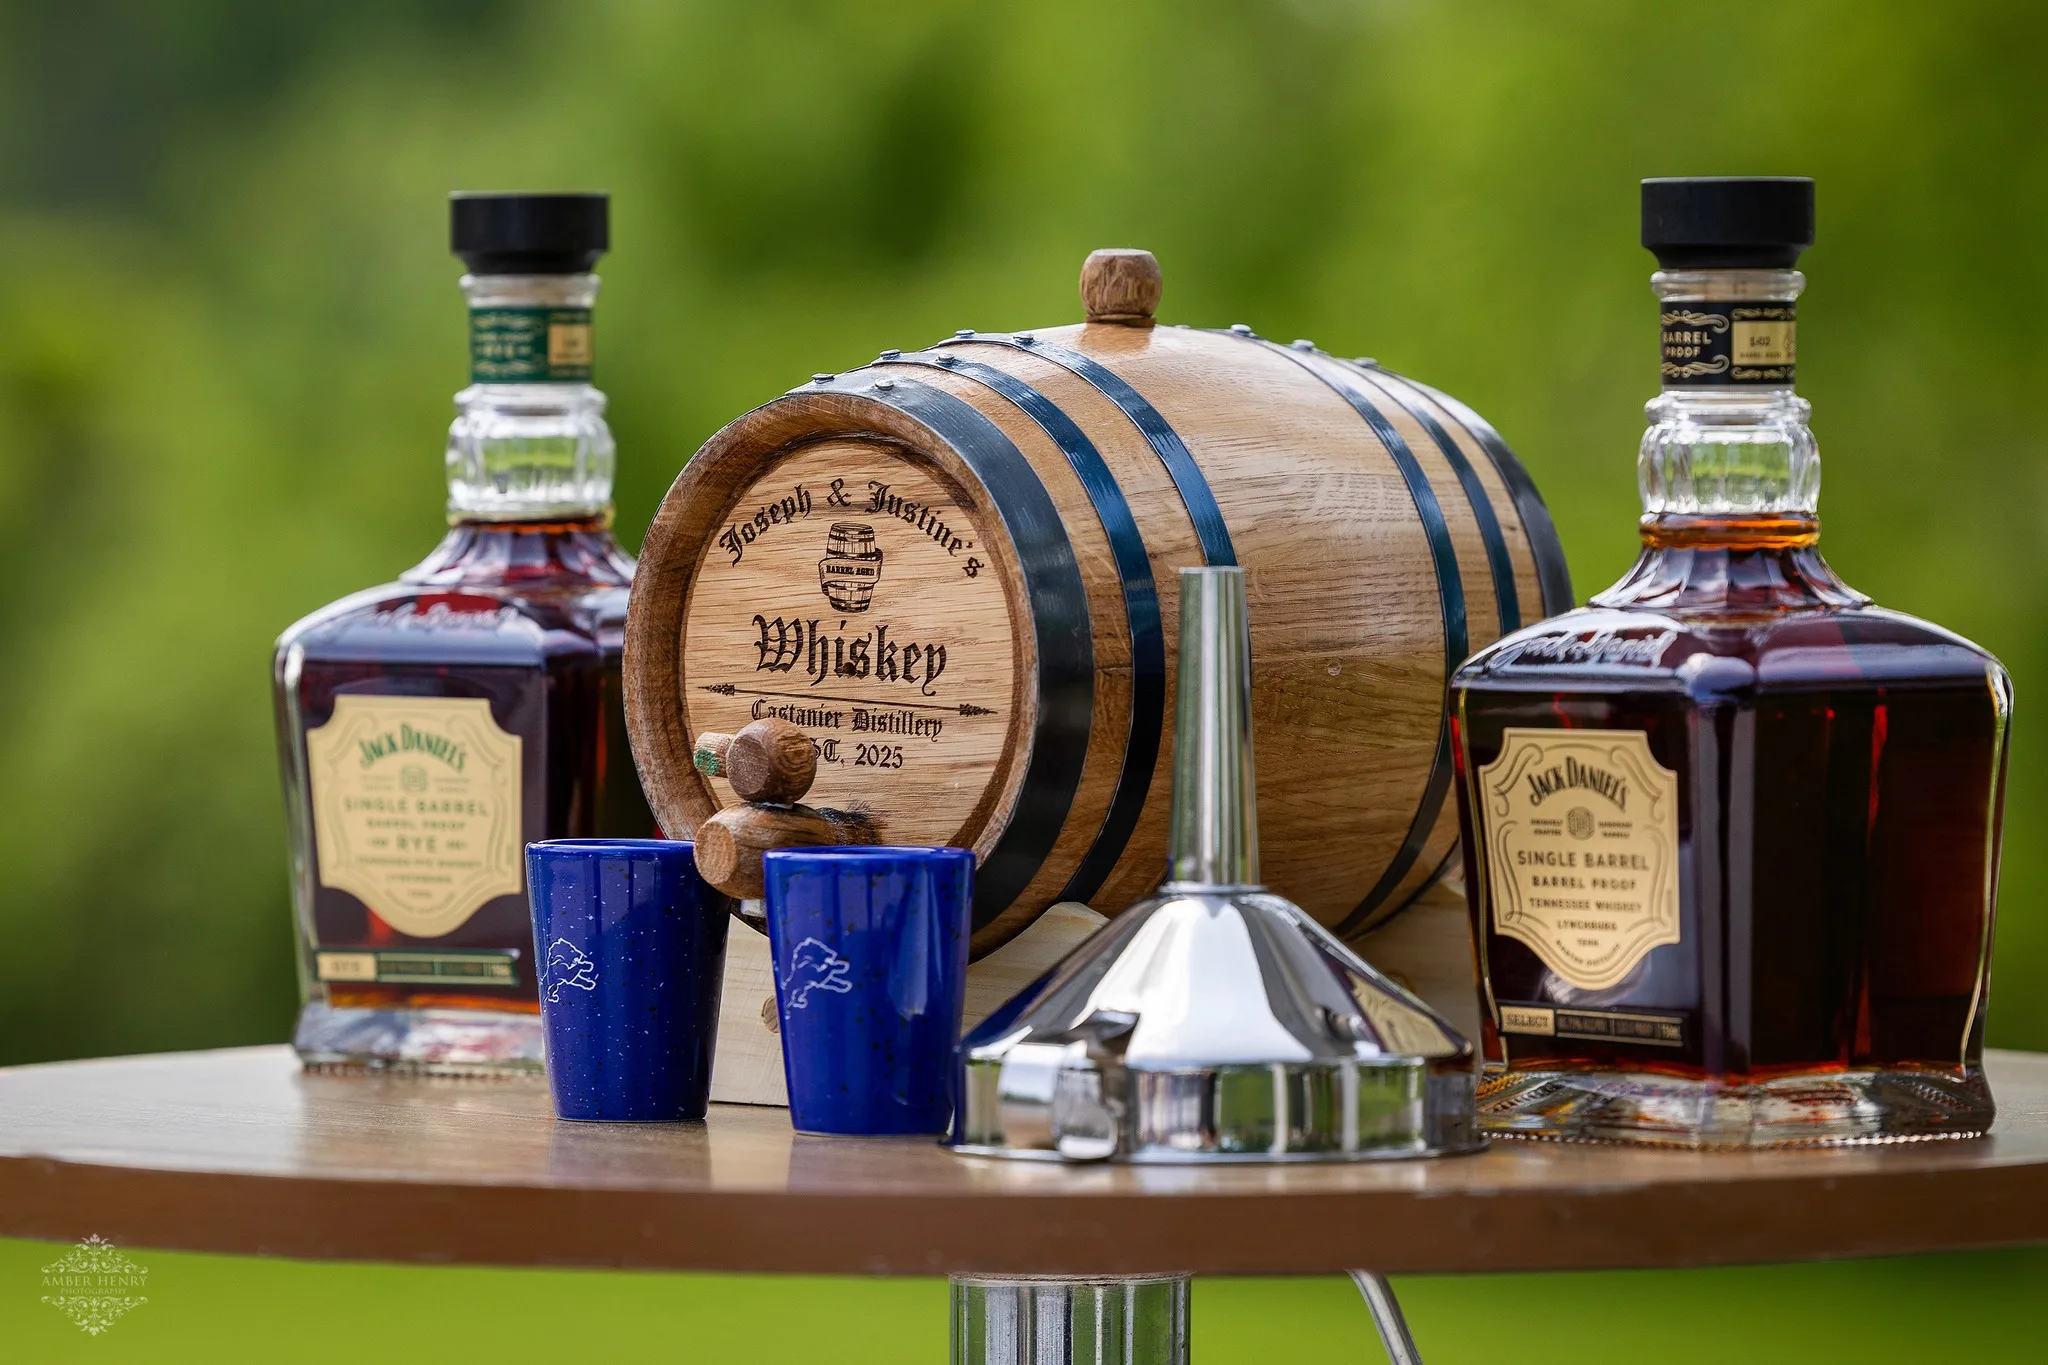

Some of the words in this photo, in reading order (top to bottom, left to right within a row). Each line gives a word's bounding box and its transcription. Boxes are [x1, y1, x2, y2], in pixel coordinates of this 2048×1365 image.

[1663, 331, 1712, 345] BARREL
[1665, 346, 1701, 358] PROOF
[719, 484, 812, 567] Joseph
[826, 477, 852, 507] &
[865, 480, 985, 579] Justine's
[826, 565, 855, 575] BARREL
[855, 568, 875, 576] AGED
[752, 614, 947, 696] Whiskey
[751, 699, 843, 729] Castanier
[851, 707, 943, 742] Distillery
[358, 732, 399, 770] JACK
[854, 743, 903, 769] 2025
[1527, 765, 1566, 807] JACK
[1566, 755, 1629, 813] DANIEL'S
[345, 796, 408, 814] SINGLE
[416, 798, 490, 817] BARREL
[397, 833, 437, 854] RYE
[1517, 850, 1577, 867] SINGLE
[1584, 852, 1650, 871] BARREL
[1532, 875, 1585, 888] BARREL
[1592, 878, 1637, 890] PROOF
[1528, 897, 1591, 910] TENNESSEE
[1596, 900, 1643, 912] WHISKEY
[1557, 919, 1618, 931] LYNCHBURG
[1506, 1013, 1549, 1028] SELECT
